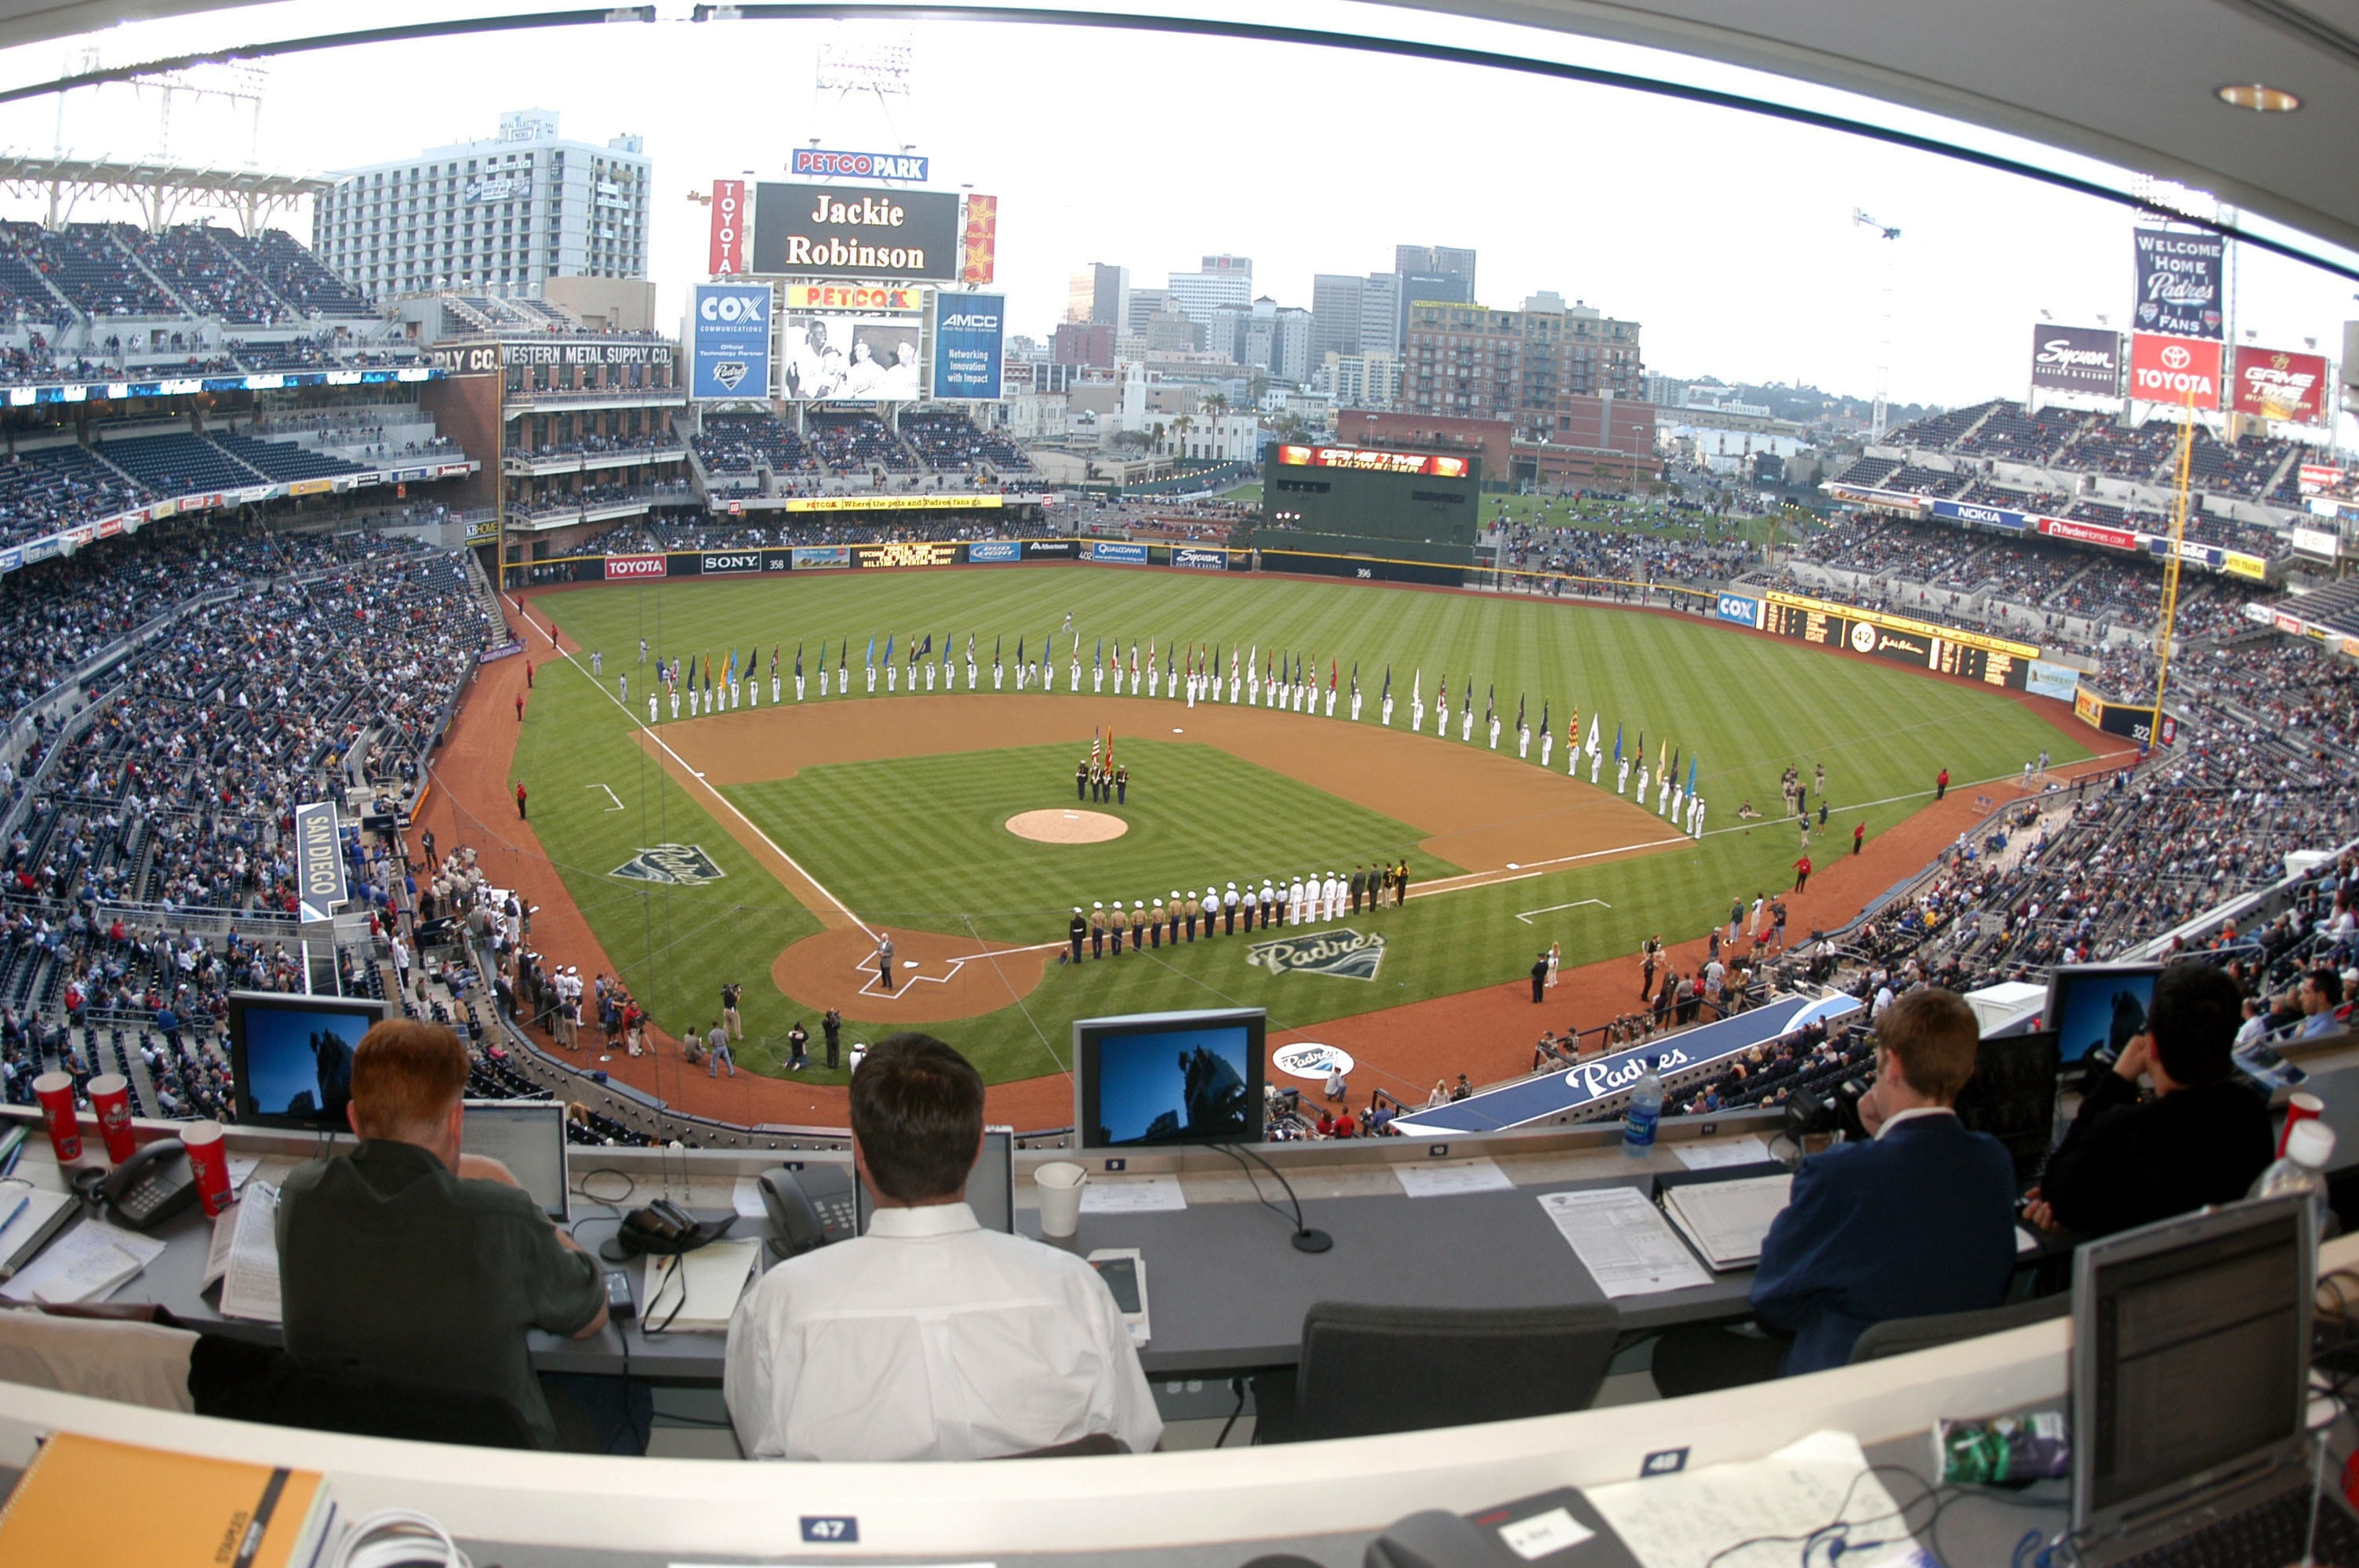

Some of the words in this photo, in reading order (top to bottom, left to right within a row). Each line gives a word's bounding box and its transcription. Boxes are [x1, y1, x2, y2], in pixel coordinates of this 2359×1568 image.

[798, 151, 872, 174] PETCO
[873, 157, 924, 179] PARK
[812, 194, 904, 227] Jackie
[718, 183, 736, 273] TOYOTA
[786, 235, 925, 269] Robinson
[2138, 237, 2221, 257] WELCOME
[2155, 256, 2206, 274] HOME
[2148, 272, 2214, 302] Padres
[807, 287, 887, 307] PETCO
[701, 295, 765, 325] COX
[942, 314, 998, 328] AMCC
[2159, 315, 2200, 332] FANS
[471, 349, 498, 370] CO.
[501, 346, 560, 364] WESTERN
[565, 347, 604, 364] METAL
[606, 347, 647, 365] SUPPLY
[652, 347, 671, 365] CO.
[949, 349, 988, 361] Networking
[2037, 339, 2114, 370] Sycuan
[713, 365, 748, 381] Padres
[951, 361, 986, 371] Innovation
[2036, 366, 2068, 376] CASINO
[2081, 371, 2113, 381] RESORT
[947, 373, 962, 383] with
[964, 374, 988, 385] Impact
[2136, 368, 2212, 394] TOYOTA
[2245, 367, 2316, 387] GAME
[2250, 381, 2306, 400] TIME
[1320, 448, 1379, 463] GAME
[1379, 452, 1427, 466] TIME
[1326, 459, 1420, 474] BUDWEISER
[1958, 507, 2001, 523] NOKIA
[1079, 551, 1092, 561] 402
[1098, 544, 1142, 555] QUALCOMM
[1176, 550, 1222, 564] Sycuan
[609, 560, 663, 574] TOYOTA
[705, 556, 758, 569] SONY
[769, 560, 783, 570] 358
[1357, 568, 1371, 579] 396
[1720, 597, 1754, 620] COX
[1855, 631, 1871, 644] 42
[2132, 724, 2150, 741] 322
[307, 816, 329, 847] SAN
[309, 849, 336, 895] DIEGO
[1247, 931, 1386, 975] Padres
[1434, 1146, 1444, 1155] 10
[214, 1511, 249, 1564] STAPLES
[811, 1520, 845, 1539] 47
